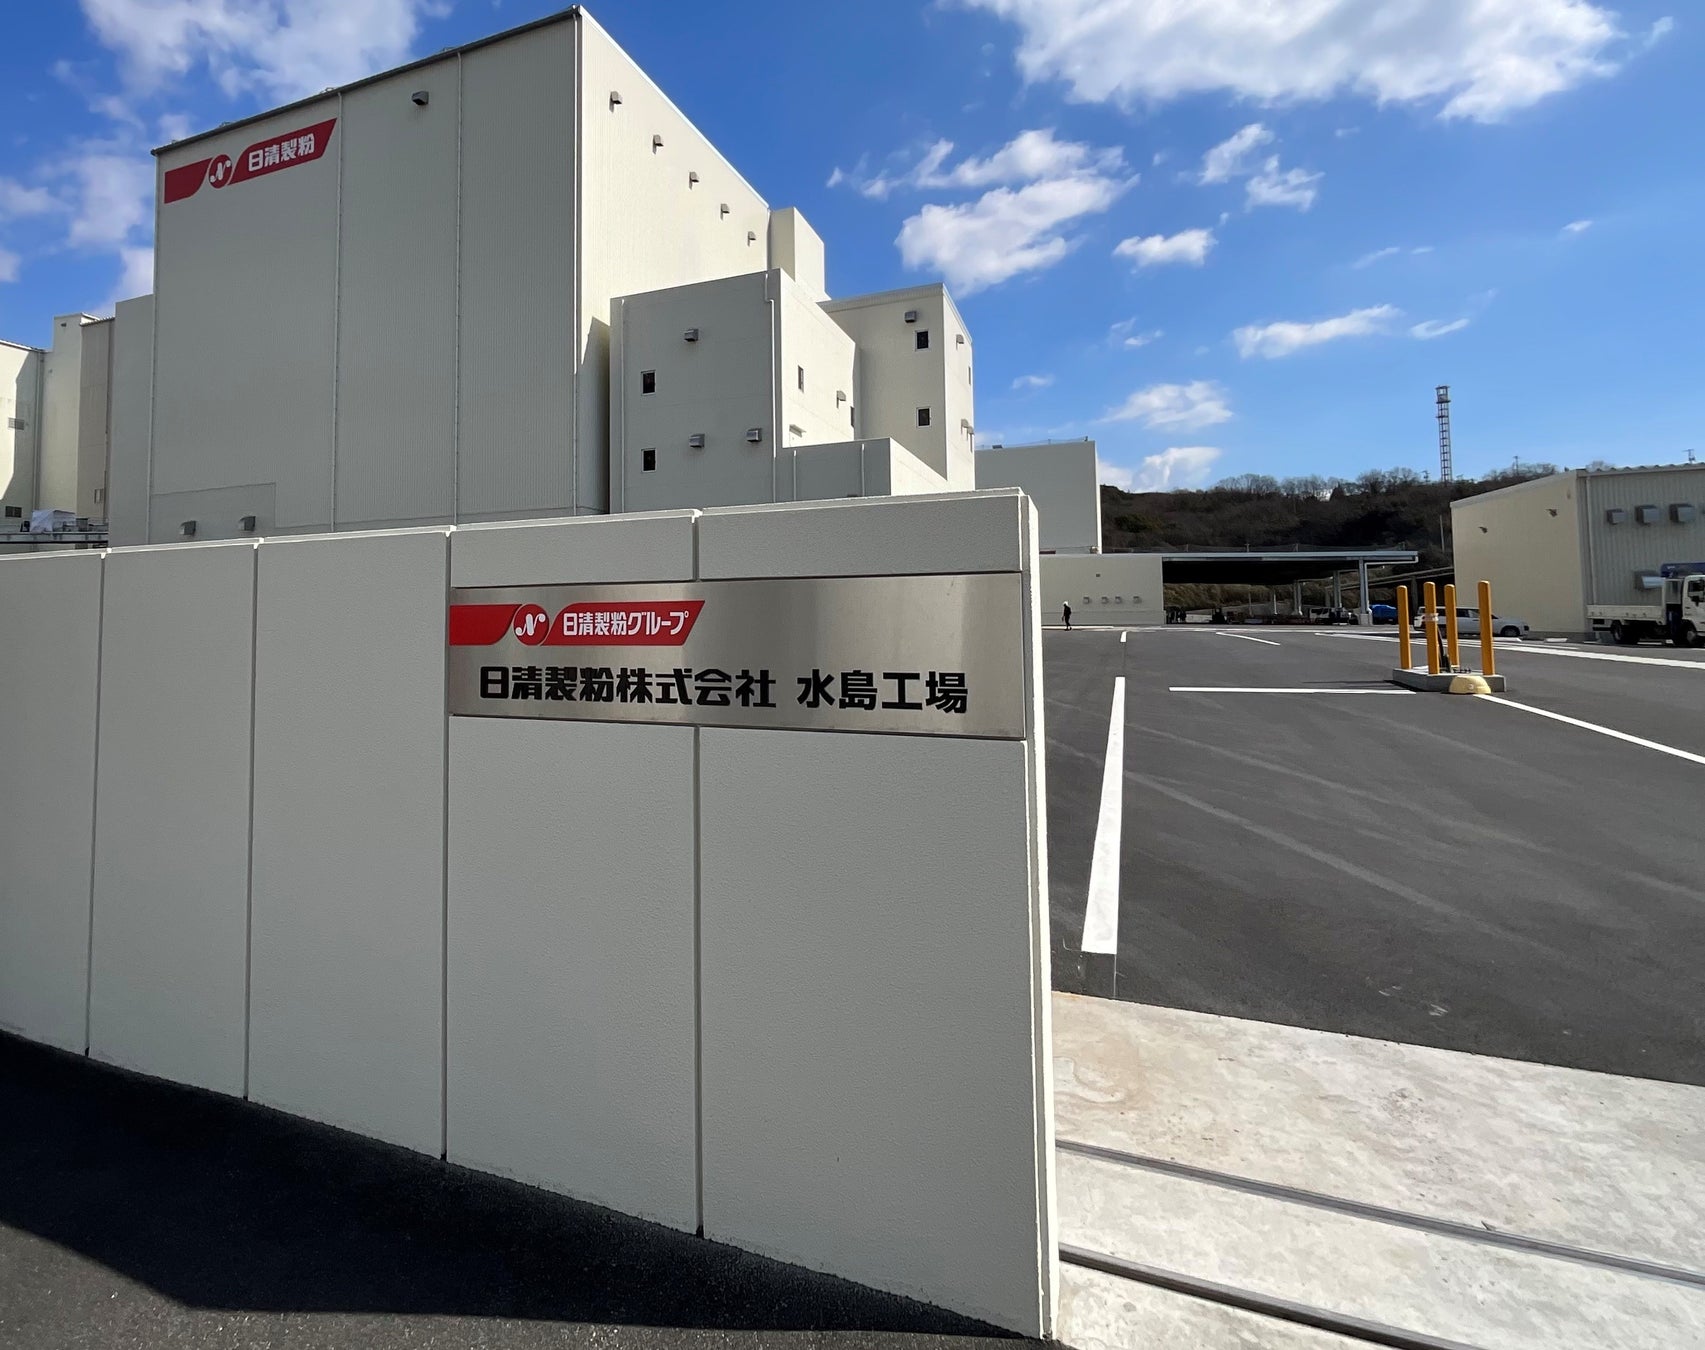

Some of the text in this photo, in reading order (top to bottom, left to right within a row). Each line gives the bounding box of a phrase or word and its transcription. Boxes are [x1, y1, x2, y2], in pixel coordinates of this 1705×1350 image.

[248, 133, 315, 172] 日清製粉
[563, 610, 690, 636] 日清製粉グループ
[480, 665, 969, 714] 日清製粉株式会社 水島工場
